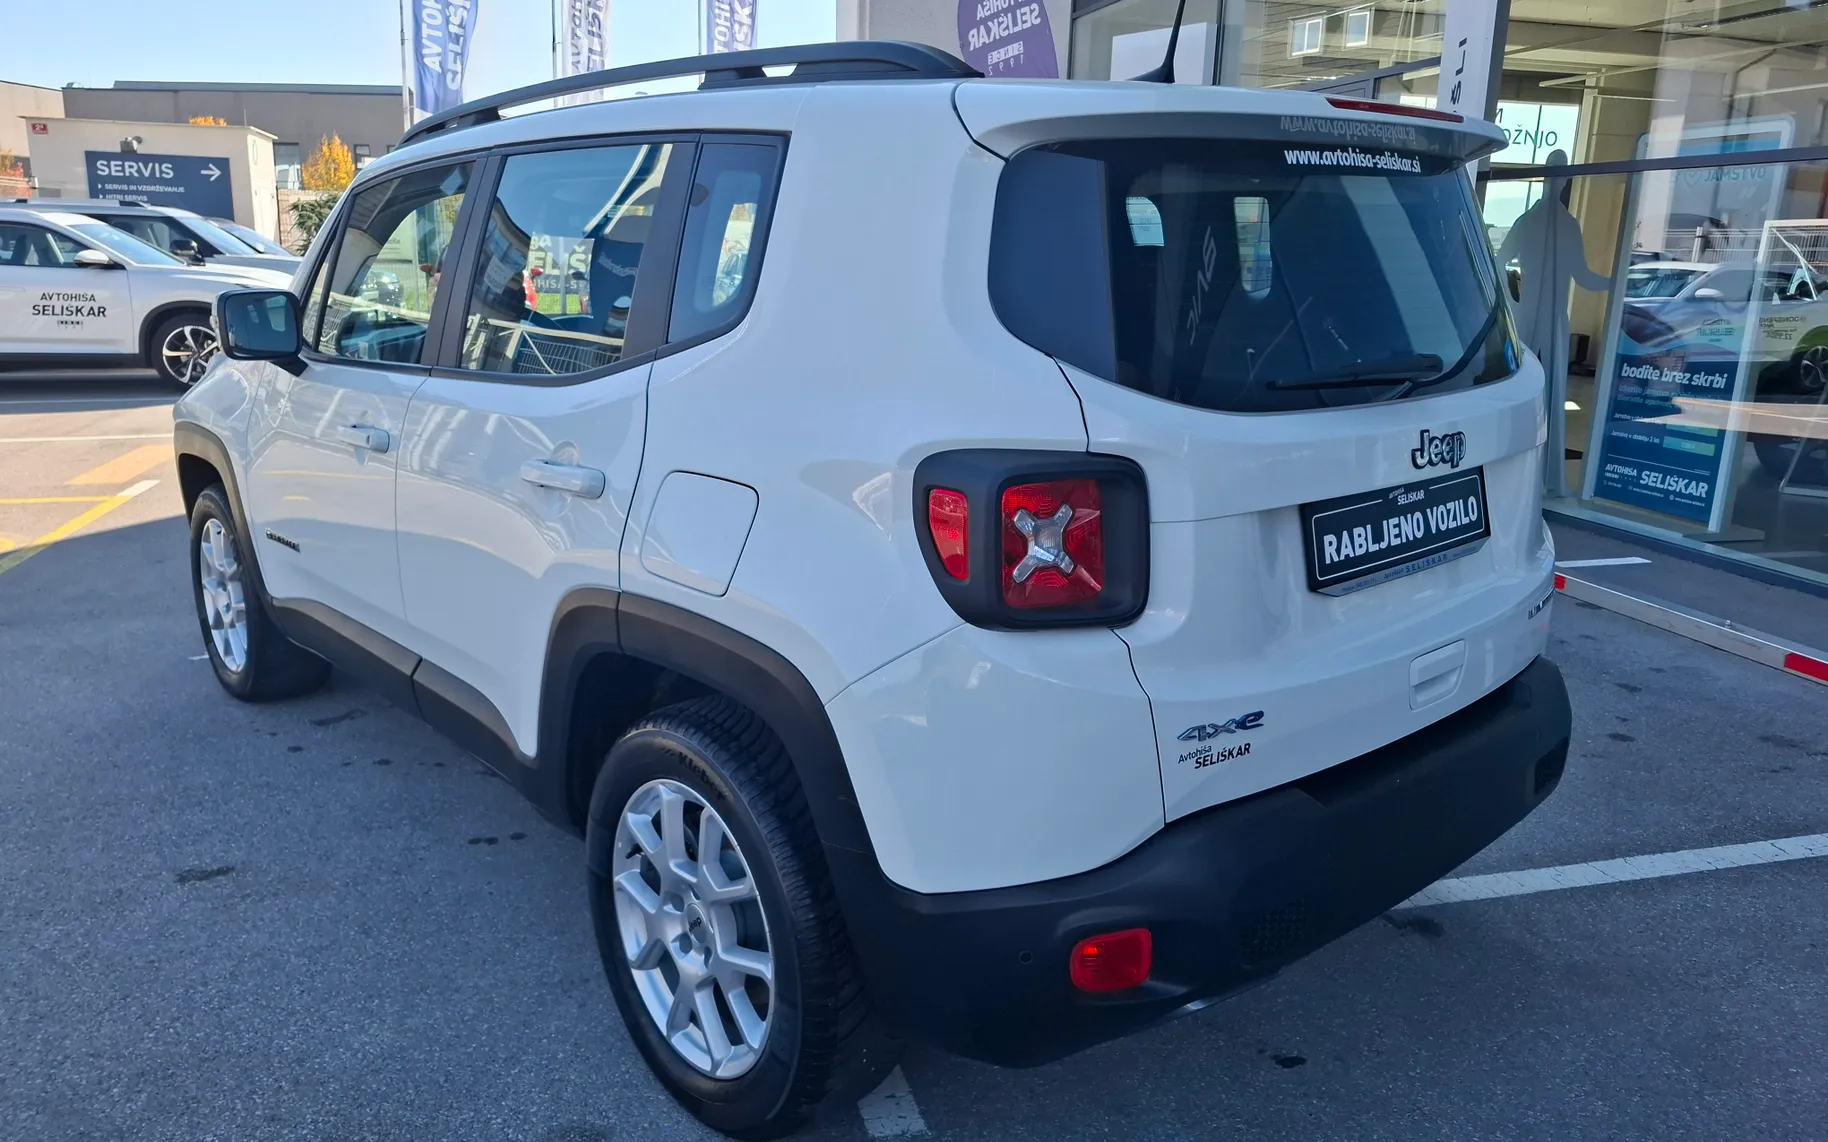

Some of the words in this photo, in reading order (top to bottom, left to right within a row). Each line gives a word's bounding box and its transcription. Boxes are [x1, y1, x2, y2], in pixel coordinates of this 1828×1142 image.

[96, 160, 174, 179] SERVIS
[1284, 147, 1421, 173] www.avtohisa-seliskar.si
[104, 183, 128, 191] SERVIS
[40, 292, 97, 302] AVTOHIŠA
[32, 304, 107, 318] SELIŠKAR
[1621, 363, 1660, 380] bodite
[1661, 367, 1691, 384] brez
[1691, 371, 1728, 389] skrbi
[1411, 429, 1467, 470] Jeep
[1605, 464, 1637, 477] AVTOHIŠA
[1640, 471, 1708, 497] SELIŠKAR
[1398, 490, 1425, 505] SELIŠKAR
[1323, 511, 1425, 564] RABLJENO
[1426, 495, 1478, 534] VOZILO
[1405, 554, 1448, 573] SELIŠKAR
[1178, 745, 1212, 764] Avtohiša
[1194, 742, 1251, 769] SELIŠKAR
